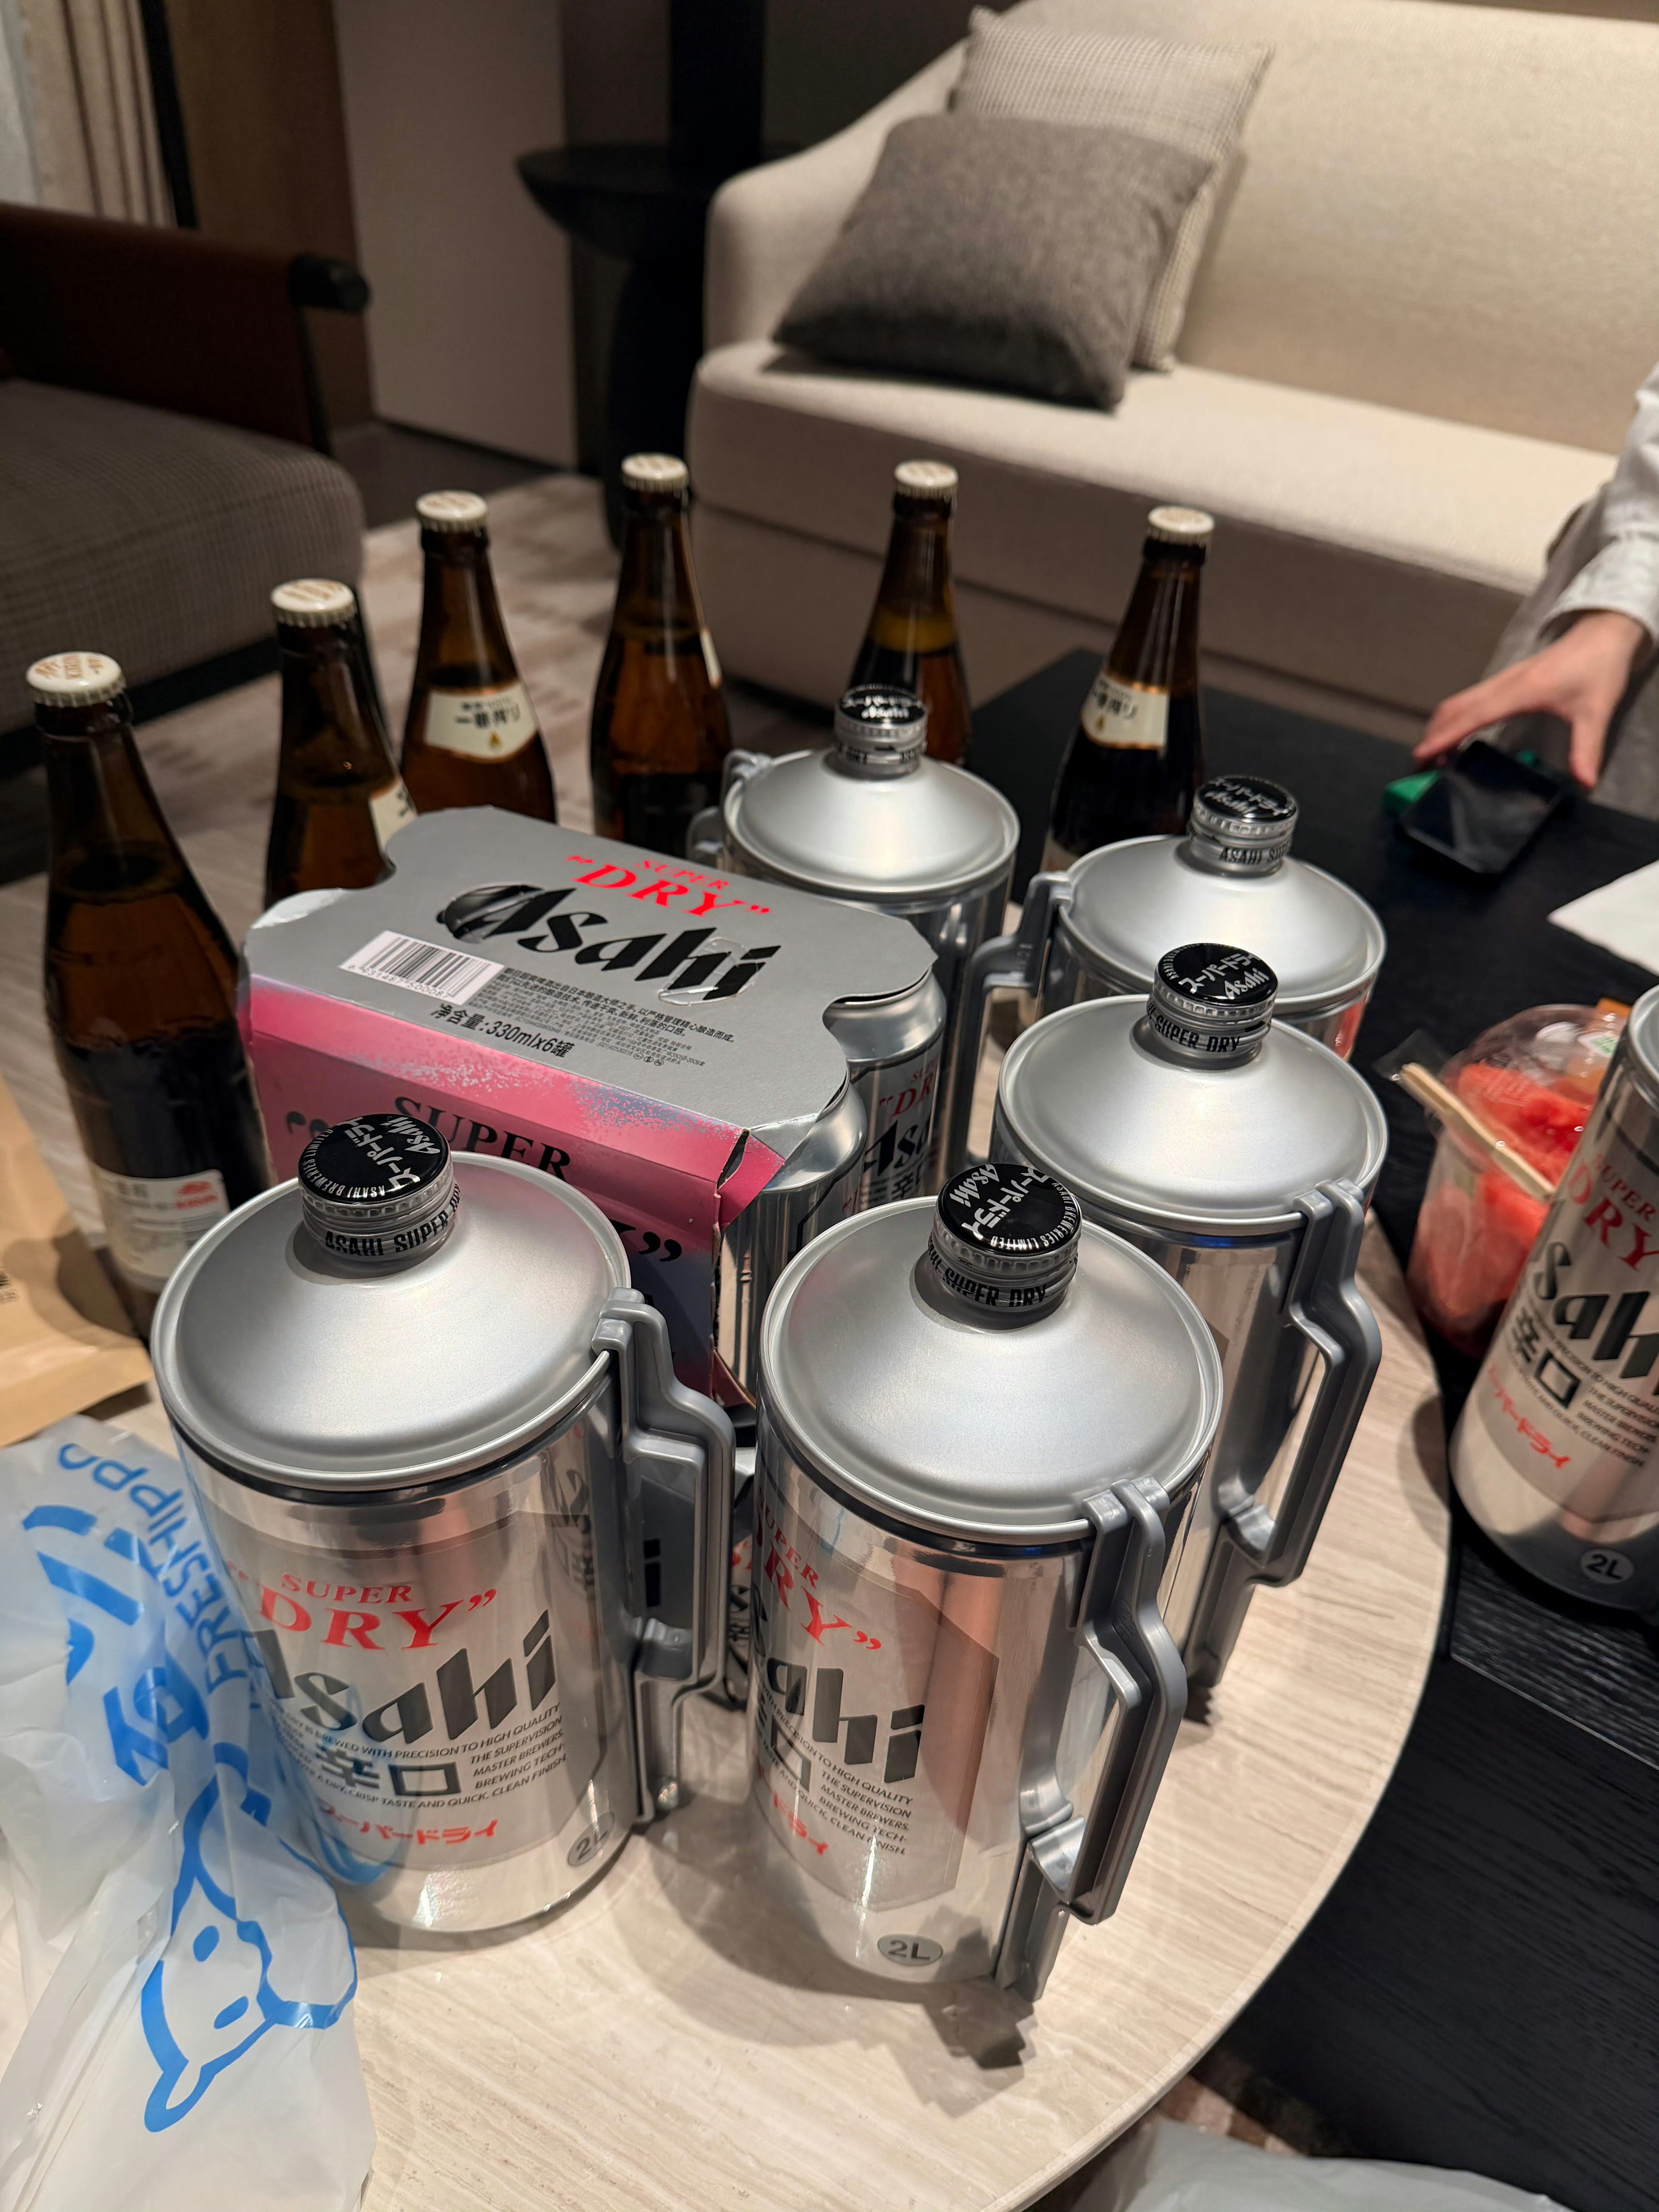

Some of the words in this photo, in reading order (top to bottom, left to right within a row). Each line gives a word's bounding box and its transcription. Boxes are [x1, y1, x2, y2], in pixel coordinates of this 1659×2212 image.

[635, 859, 729, 891] SUPER
[436, 884, 781, 1000] Asahi
[1224, 967, 1271, 1000] Asahi
[1154, 1015, 1199, 1050] SUPER
[1206, 1035, 1241, 1053] DRY
[304, 1128, 334, 1156] LIMITED
[380, 1116, 441, 1154] Asahi
[302, 1156, 345, 1196] BREWERIES
[347, 1185, 385, 1199] ASAHI
[949, 1163, 1000, 1208] Asahi
[1051, 1182, 1072, 1204] ASAHI
[1595, 1153, 1656, 1222] SUPER
[325, 1230, 384, 1257] ASAHI
[393, 1210, 449, 1254] SUPER
[990, 1235, 1039, 1250] LIMITED
[1040, 1206, 1077, 1247] BREWERIES
[943, 1267, 1000, 1307] SUPER
[1009, 1284, 1046, 1307] DRY
[1585, 1553, 1623, 1581] 2L
[281, 1573, 413, 1604] SUPER
[315, 1731, 360, 1752] BREWED
[362, 1746, 393, 1758] WITH
[395, 1746, 460, 1759] PRECISION
[462, 1741, 479, 1753] TO
[480, 1730, 511, 1748] HIGH
[513, 1702, 561, 1735] QUALITY
[471, 1752, 493, 1765] THE
[495, 1715, 563, 1757] SUPERVISION
[315, 1742, 462, 1796] 辛口
[473, 1756, 517, 1777] MASTER
[776, 1707, 817, 1756] PRECISION
[818, 1752, 832, 1767] TO
[831, 1762, 860, 1786] HIGH
[862, 1781, 913, 1805] QUALITY
[349, 1789, 379, 1804] CRISP
[381, 1797, 417, 1808] TASTE
[416, 1799, 445, 1809] AND
[492, 1776, 530, 1796] CLEAN
[475, 1762, 531, 1790] BREWING
[821, 1770, 840, 1786] THE
[841, 1784, 912, 1818] SUPERVISION
[780, 1769, 797, 1790] AND
[830, 1816, 866, 1841] CLEAN
[819, 1796, 870, 1831] BREWING
[821, 1784, 859, 1811] MASTER
[576, 1831, 606, 1861] 2L
[887, 1939, 930, 1961] 2L
